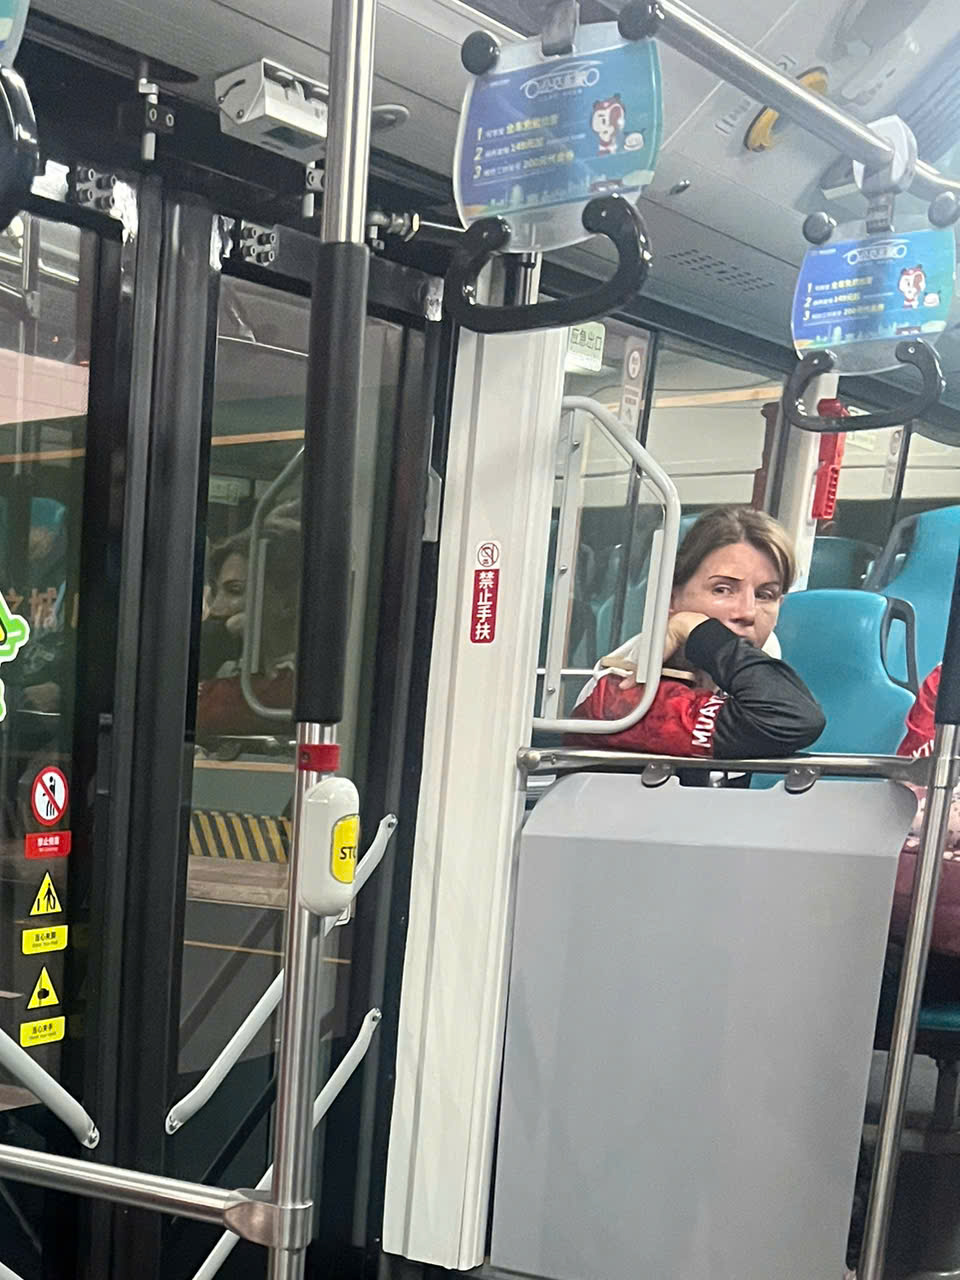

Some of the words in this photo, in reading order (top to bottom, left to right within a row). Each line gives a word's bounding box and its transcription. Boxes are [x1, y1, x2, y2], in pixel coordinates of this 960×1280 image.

[476, 127, 483, 141] 1
[473, 147, 483, 161] 2
[473, 164, 482, 180] 3
[804, 297, 812, 308] 2
[475, 571, 495, 640] 禁止手扶
[339, 847, 356, 860] ST
